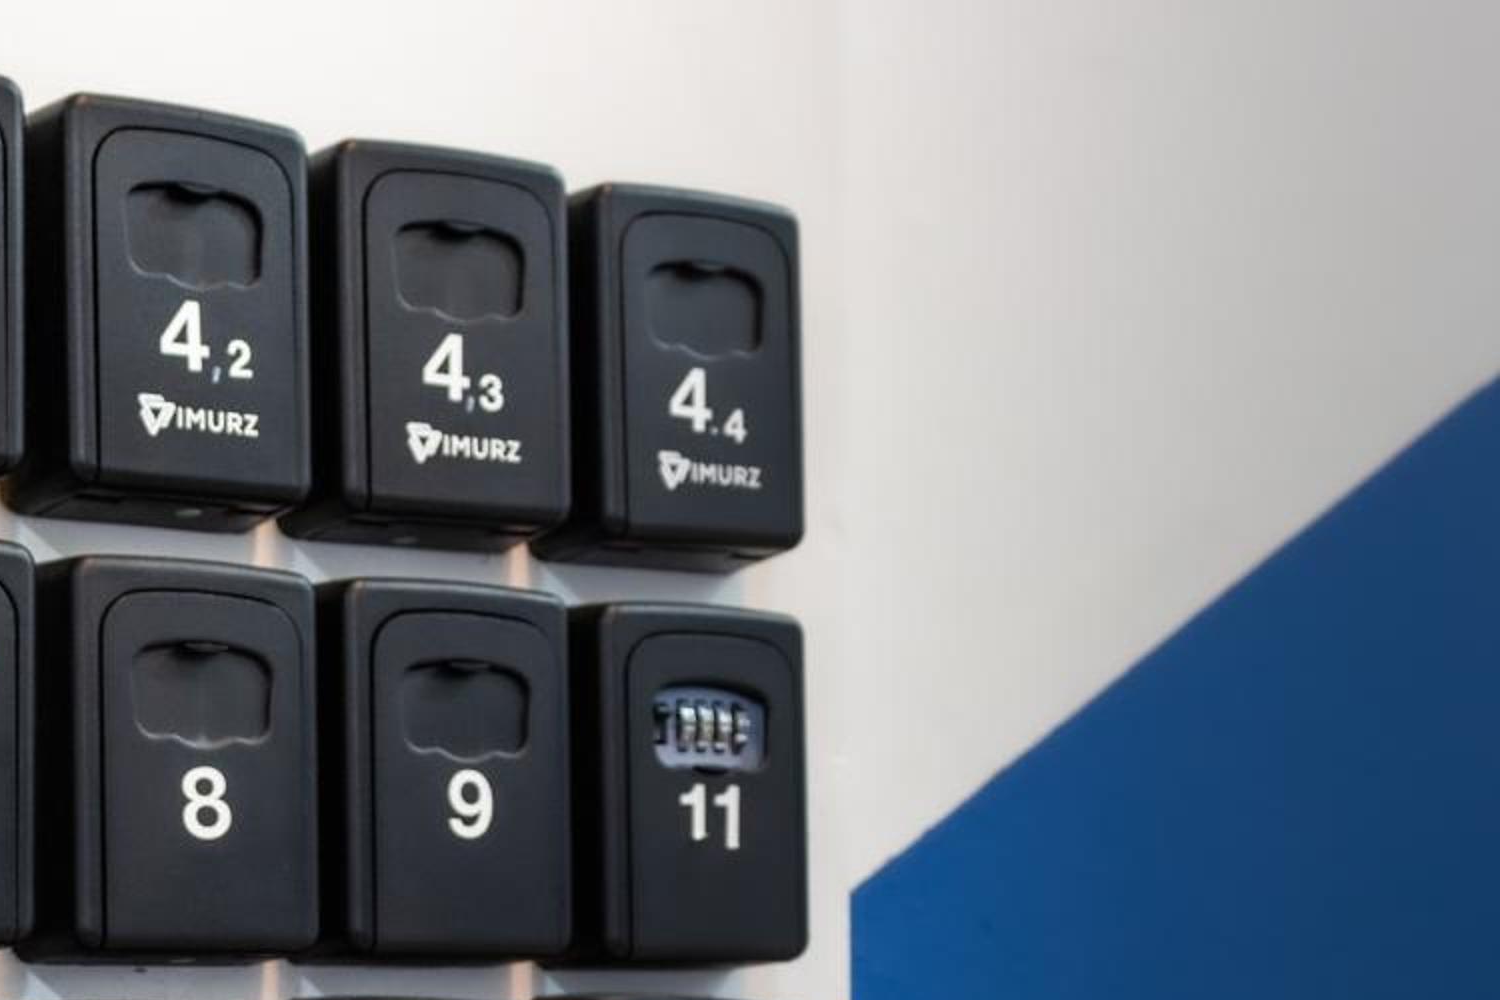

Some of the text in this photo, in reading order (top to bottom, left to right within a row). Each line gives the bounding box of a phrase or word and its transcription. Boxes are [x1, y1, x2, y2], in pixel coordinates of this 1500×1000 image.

[181, 766, 232, 840] 8
[448, 769, 493, 839] 9
[680, 783, 740, 849] 11
